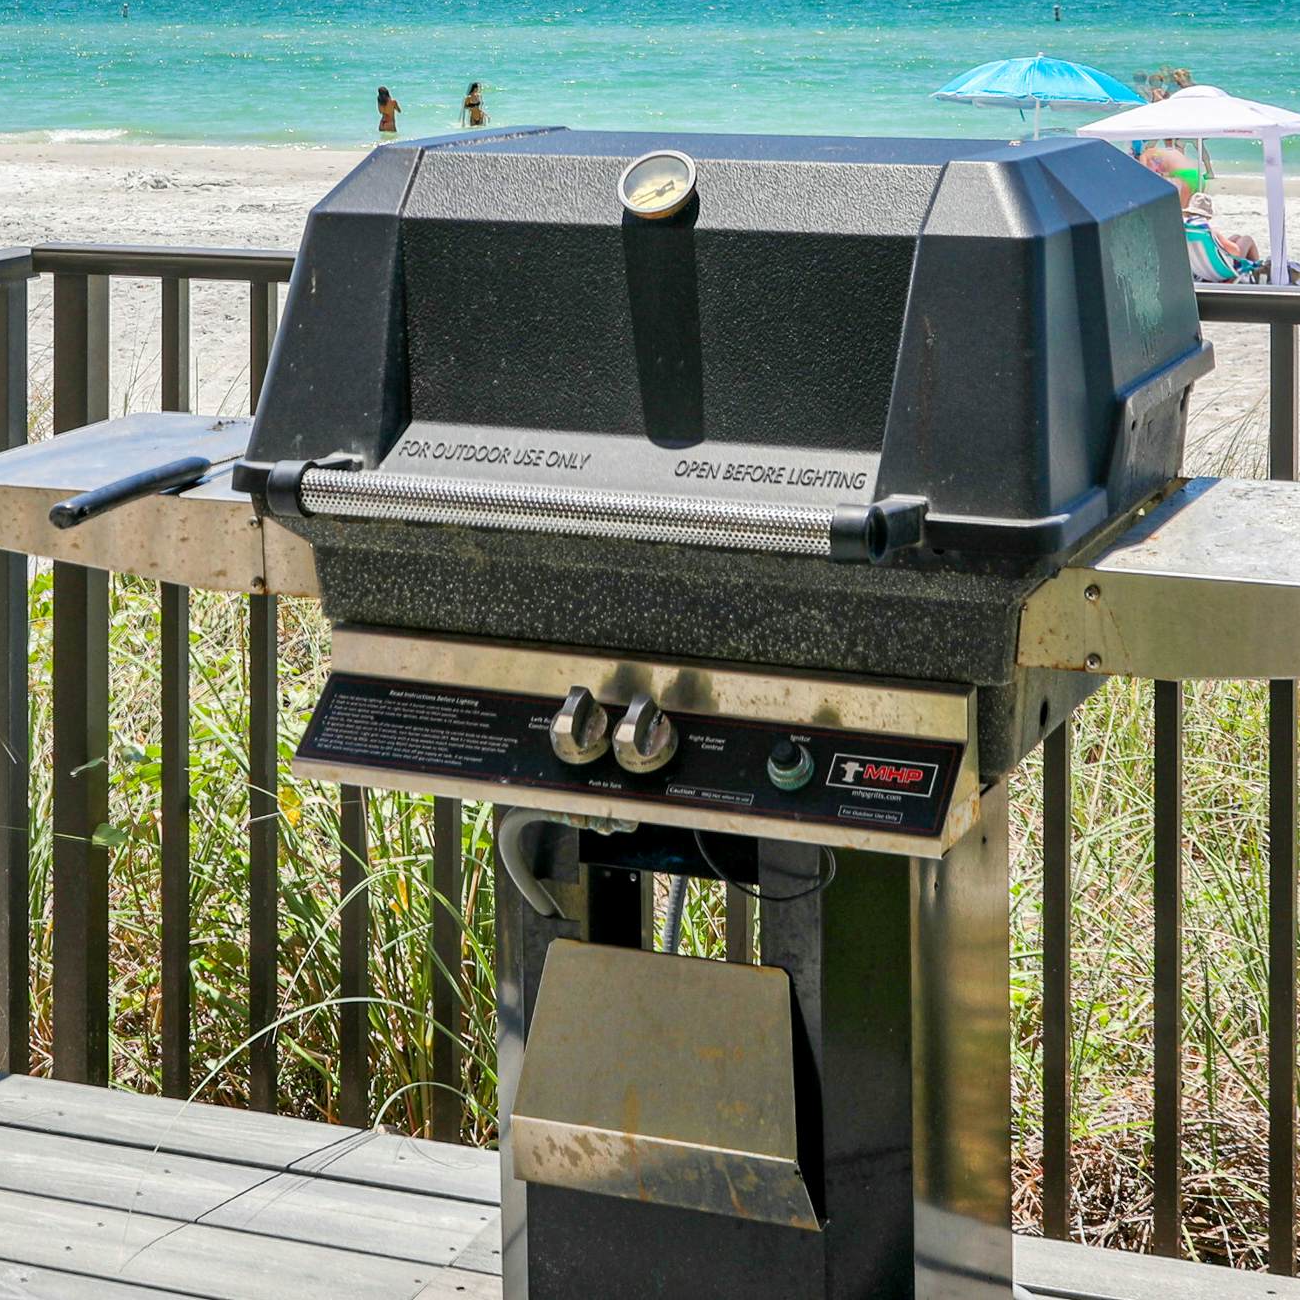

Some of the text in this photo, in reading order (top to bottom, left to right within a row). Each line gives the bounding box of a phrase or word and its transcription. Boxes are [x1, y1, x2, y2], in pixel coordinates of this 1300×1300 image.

[399, 440, 592, 470] FOR OUTDOOR USE ONLY
[674, 460, 868, 490] OPEN BEFORE LIGHTING
[389, 689, 404, 698] Read
[436, 693, 456, 703] Before
[456, 696, 479, 707] Lighting
[688, 734, 726, 744] Right Burner
[701, 743, 724, 751] Control
[863, 764, 923, 783] MHP
[851, 790, 902, 802] mhpgrills.com
